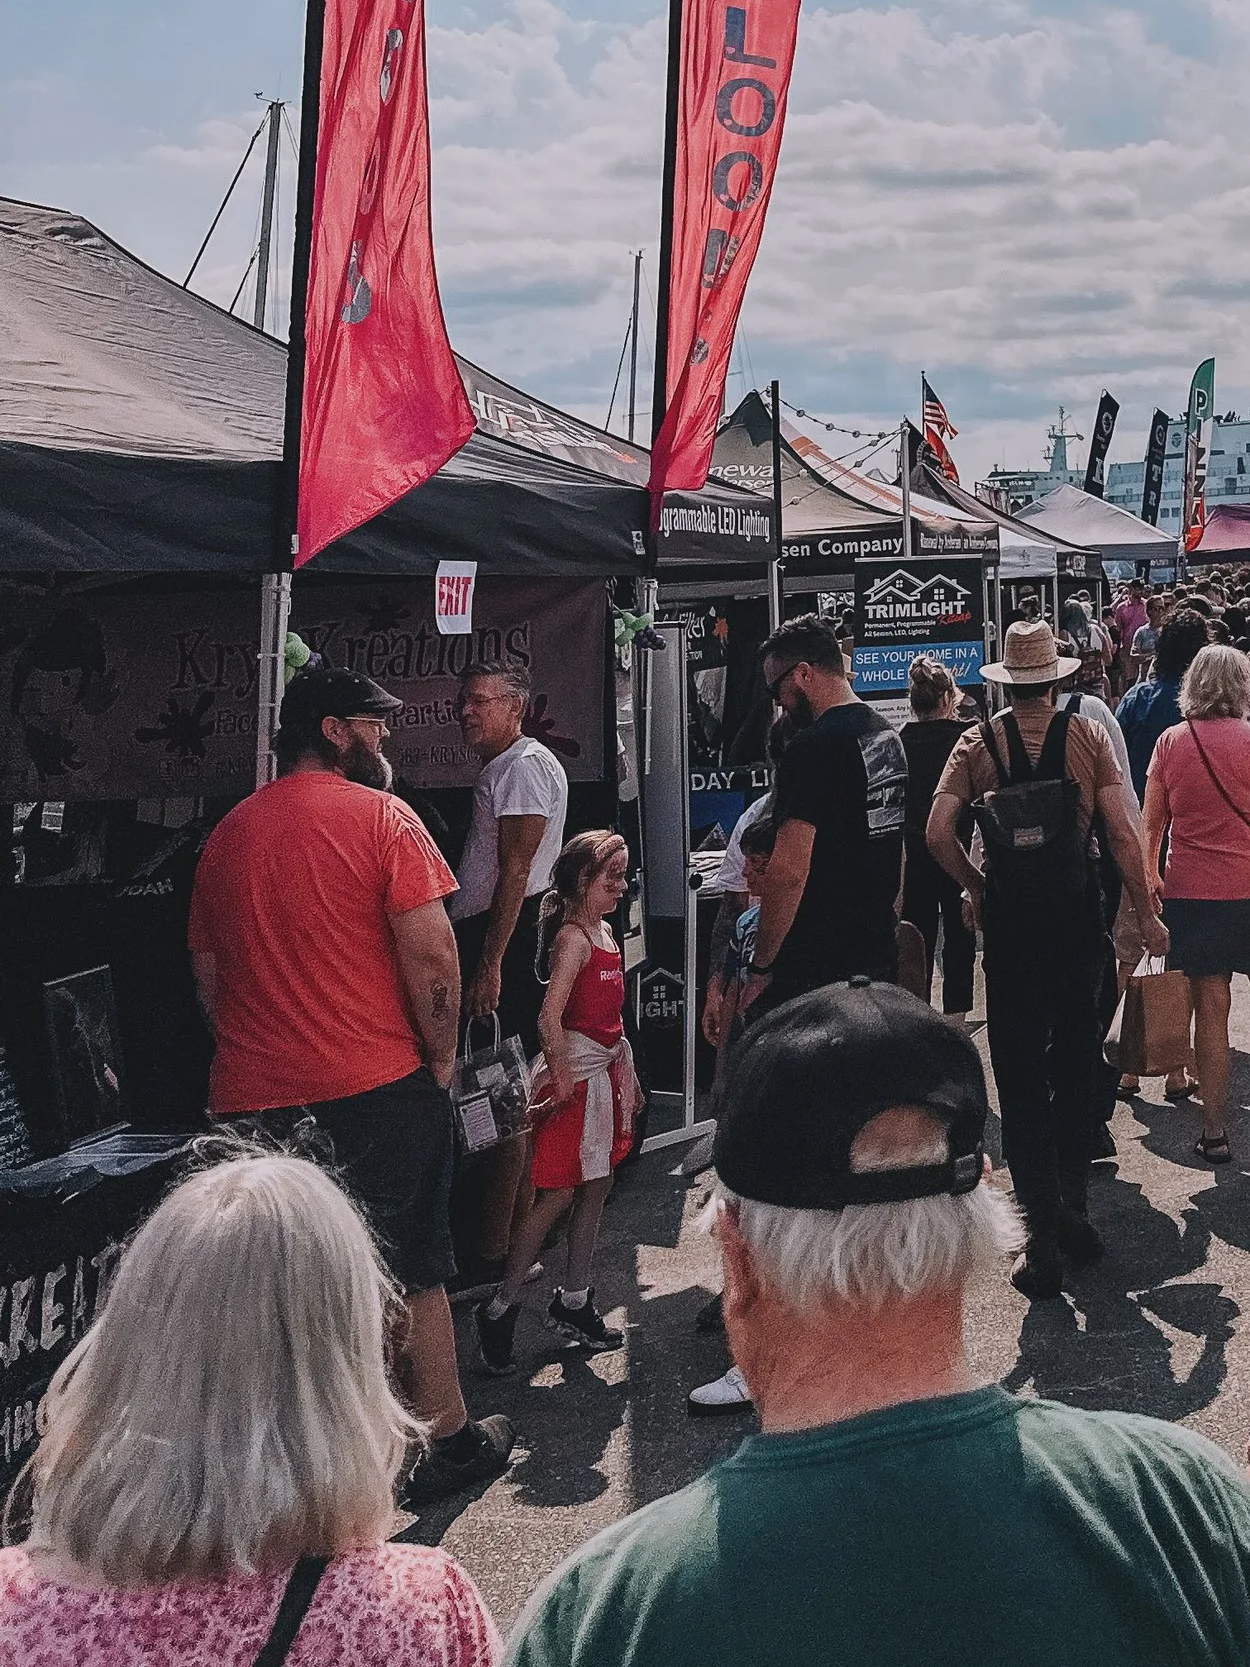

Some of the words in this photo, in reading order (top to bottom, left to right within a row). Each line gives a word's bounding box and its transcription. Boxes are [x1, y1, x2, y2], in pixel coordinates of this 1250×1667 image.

[1190, 387, 1208, 529] PIZZA
[709, 464, 774, 477] newa
[658, 504, 716, 538] grammable
[718, 506, 736, 535] LED
[737, 508, 771, 543] Lighting
[781, 543, 811, 558] sen
[817, 536, 904, 557] Company
[438, 576, 472, 616] EXIT
[864, 601, 966, 619] TRIMLIGHT
[171, 627, 258, 698] Kry
[301, 620, 532, 680] Kreations
[855, 652, 879, 665] SEE
[882, 650, 914, 663] YOUR
[918, 648, 953, 660] HOME
[955, 647, 968, 659] IN
[969, 647, 978, 658] A
[862, 668, 905, 682] WHOLE
[391, 699, 461, 728] Parti
[691, 771, 735, 791] DAY
[751, 768, 769, 788] LI
